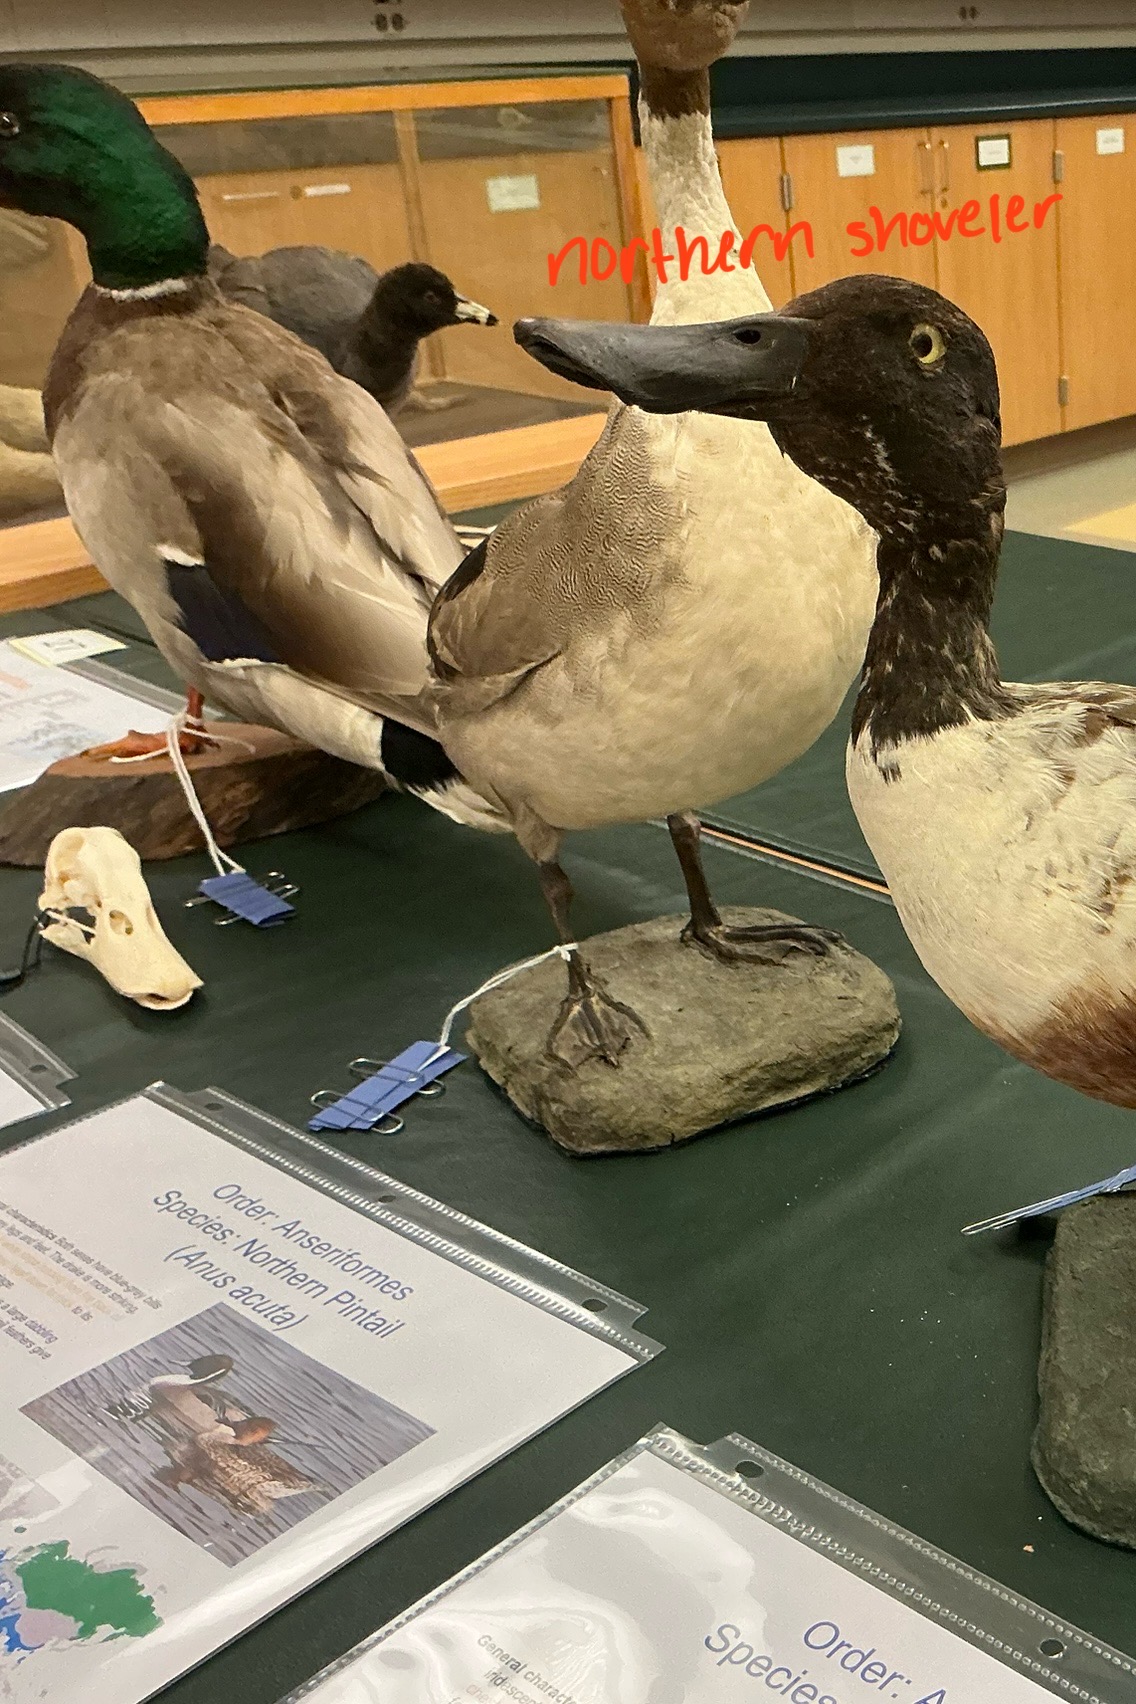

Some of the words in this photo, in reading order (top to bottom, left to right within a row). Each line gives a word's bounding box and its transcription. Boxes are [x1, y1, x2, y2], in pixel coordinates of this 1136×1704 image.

[153, 1190, 241, 1244] Species:
[233, 1238, 329, 1299] Northern
[323, 1290, 405, 1339] Pintail
[213, 1184, 280, 1225] Order:
[271, 1220, 414, 1301] Anseriformes
[163, 1244, 236, 1288] (Anus
[228, 1285, 309, 1332] acuta)
[24, 1320, 58, 1344] dabbling
[477, 1634, 528, 1674] General
[804, 1621, 912, 1699] Order:
